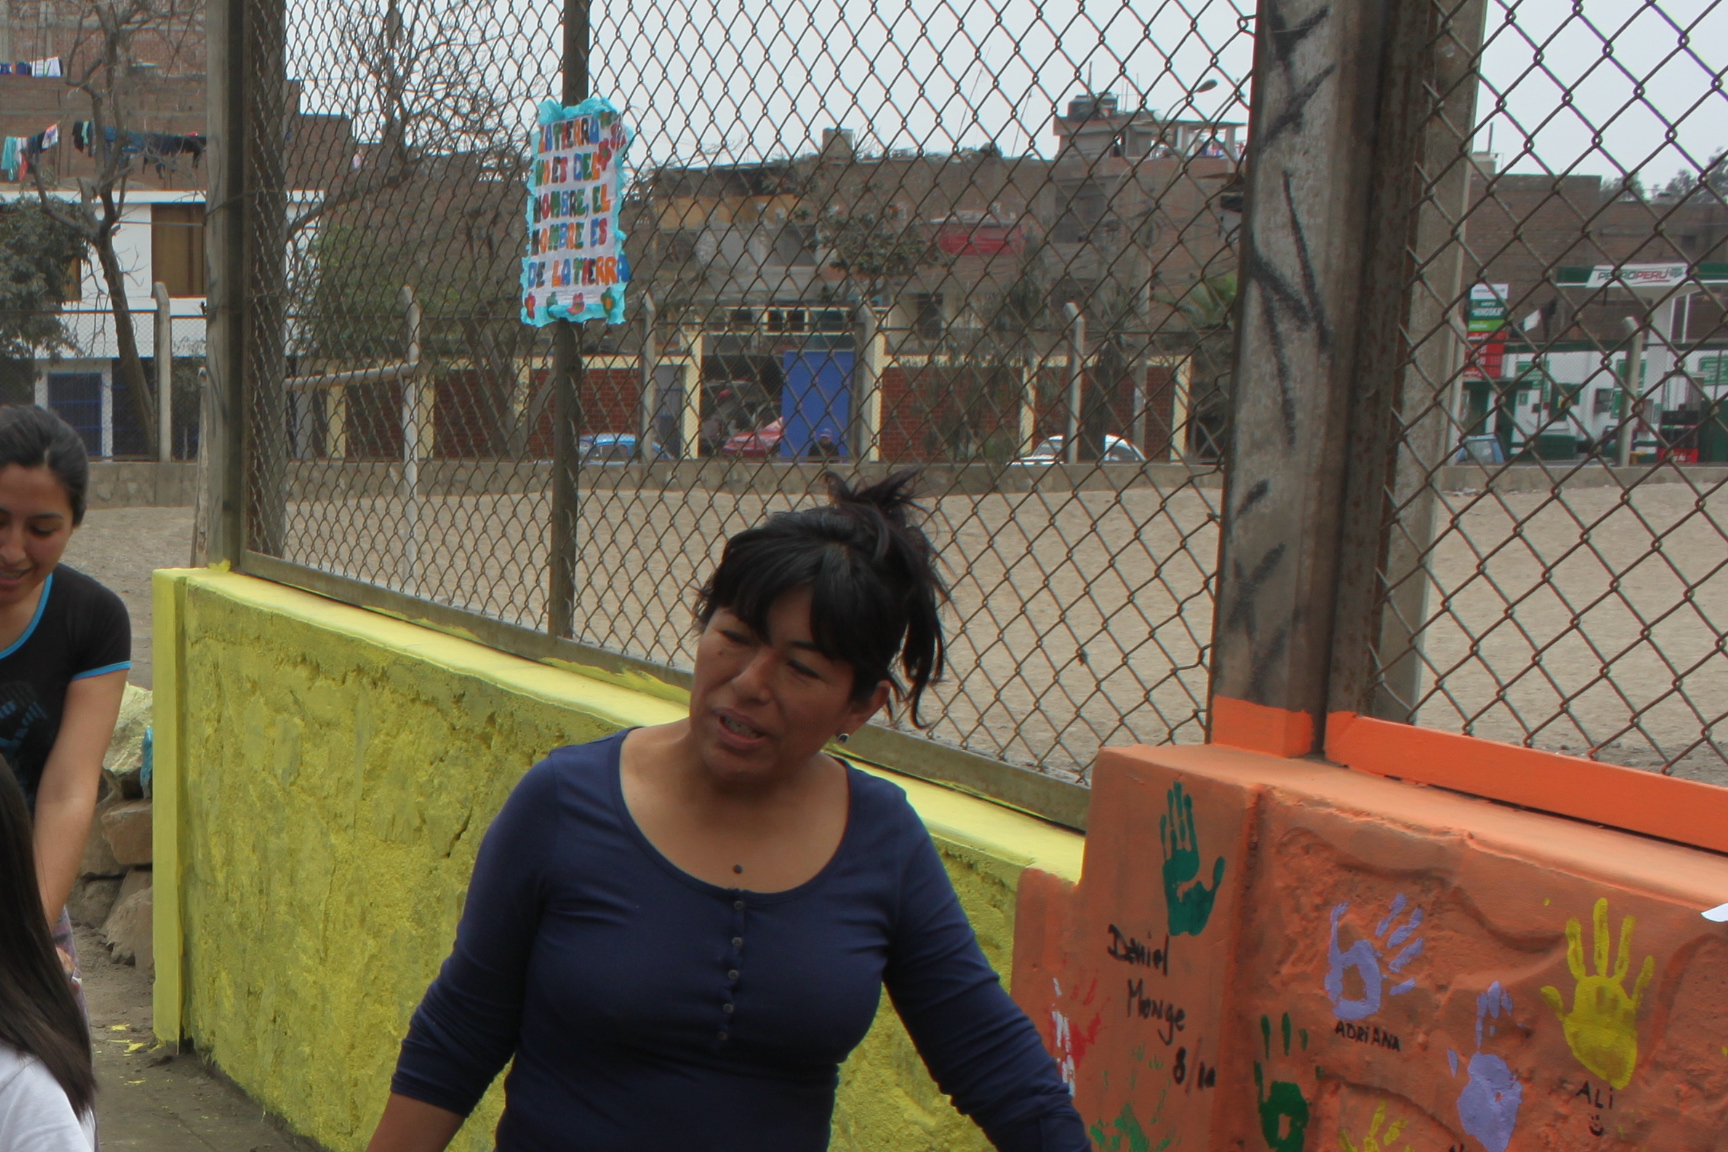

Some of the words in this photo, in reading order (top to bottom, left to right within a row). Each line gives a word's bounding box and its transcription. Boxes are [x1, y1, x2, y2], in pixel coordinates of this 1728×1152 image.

[535, 158, 551, 187] NO
[551, 155, 568, 184] ES
[573, 152, 601, 182] DEL
[592, 183, 611, 215] EL
[531, 221, 585, 256] HOMBRE
[590, 217, 608, 248] ES
[528, 260, 546, 289] DE
